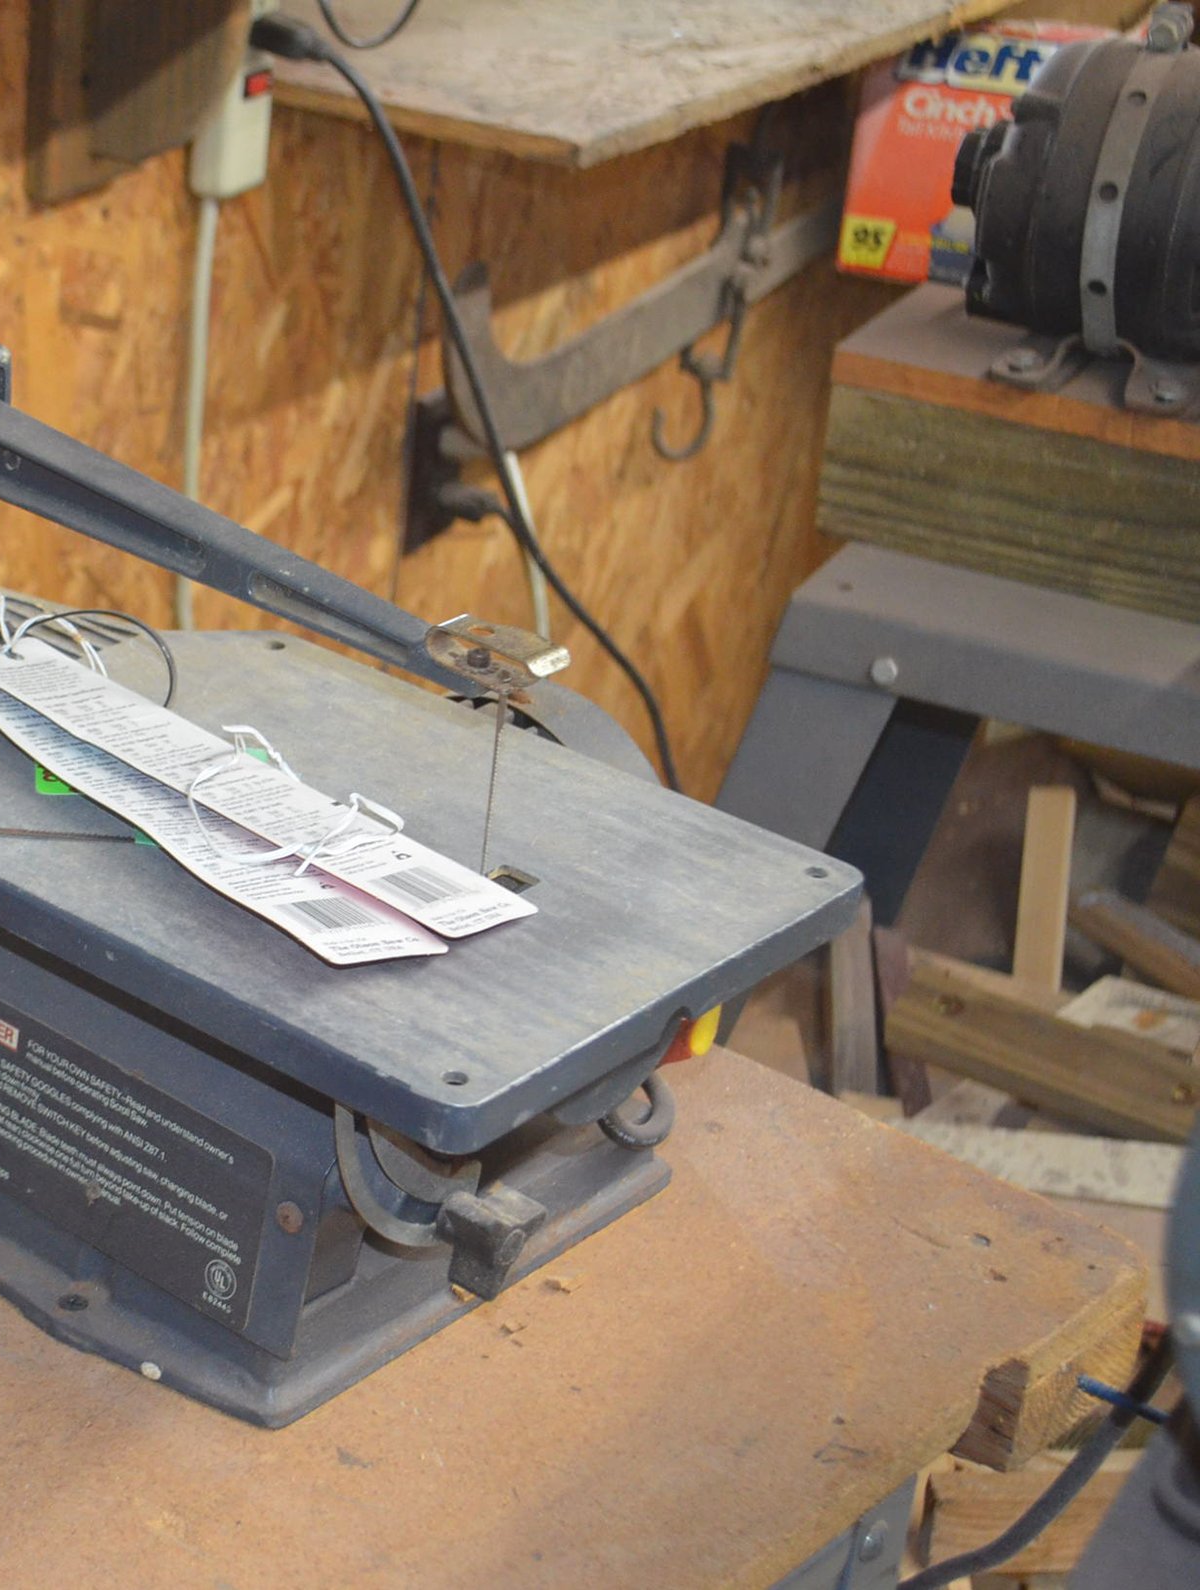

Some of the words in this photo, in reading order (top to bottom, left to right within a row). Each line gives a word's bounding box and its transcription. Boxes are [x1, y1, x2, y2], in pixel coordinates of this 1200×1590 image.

[908, 27, 1040, 80] Heft
[904, 87, 996, 128] Cinch
[0, 1058, 30, 1082] SAFETY
[31, 1076, 70, 1106] GOGGLES
[71, 1099, 107, 1127] complying
[108, 1121, 123, 1136] with
[123, 1130, 142, 1148] ANSI
[27, 1039, 45, 1057] FOR
[46, 1050, 69, 1071] YOUR
[69, 1063, 89, 1082] OWN
[146, 1106, 160, 1122] and
[161, 1115, 203, 1146] understand
[52, 1066, 74, 1085] before
[75, 1079, 109, 1105] operating
[109, 1098, 129, 1117] Scroll
[3, 1083, 36, 1109] REMOVE
[37, 1103, 69, 1129] SWITCH
[69, 1122, 85, 1138] KEY
[86, 1132, 109, 1153] before
[110, 1146, 142, 1172] adjusting
[160, 1176, 194, 1203] changing
[163, 1201, 177, 1215] Put
[177, 1210, 204, 1232] tension
[216, 1233, 238, 1252] blade
[180, 1223, 205, 1244] Follow
[205, 1238, 240, 1266] complete
